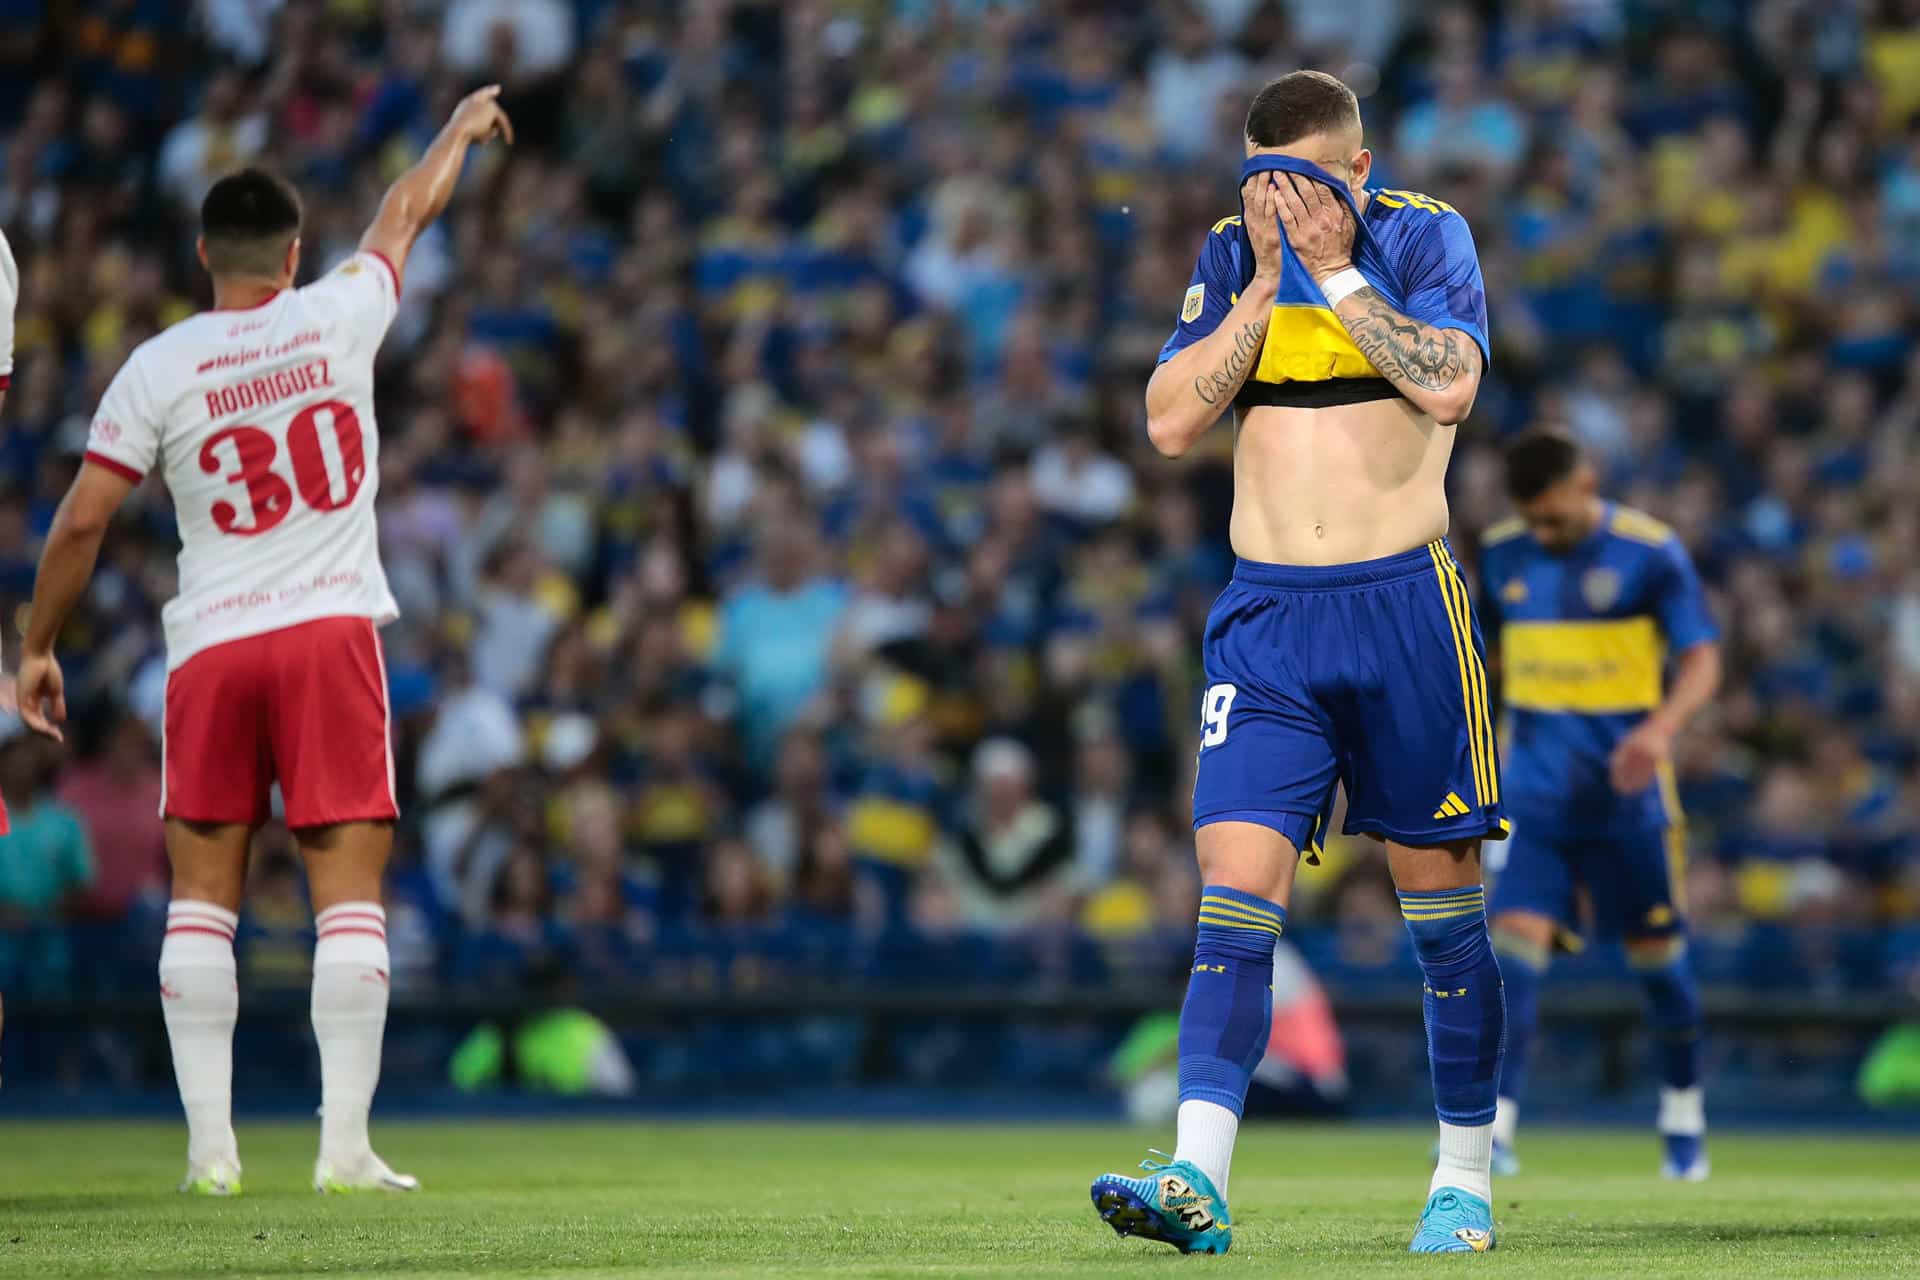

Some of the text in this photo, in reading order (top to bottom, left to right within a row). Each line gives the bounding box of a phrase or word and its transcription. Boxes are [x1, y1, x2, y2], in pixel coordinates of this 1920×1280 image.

[205, 357, 334, 419] RODRIGUEZ
[198, 399, 366, 538] 30
[1200, 683, 1237, 752] 9
